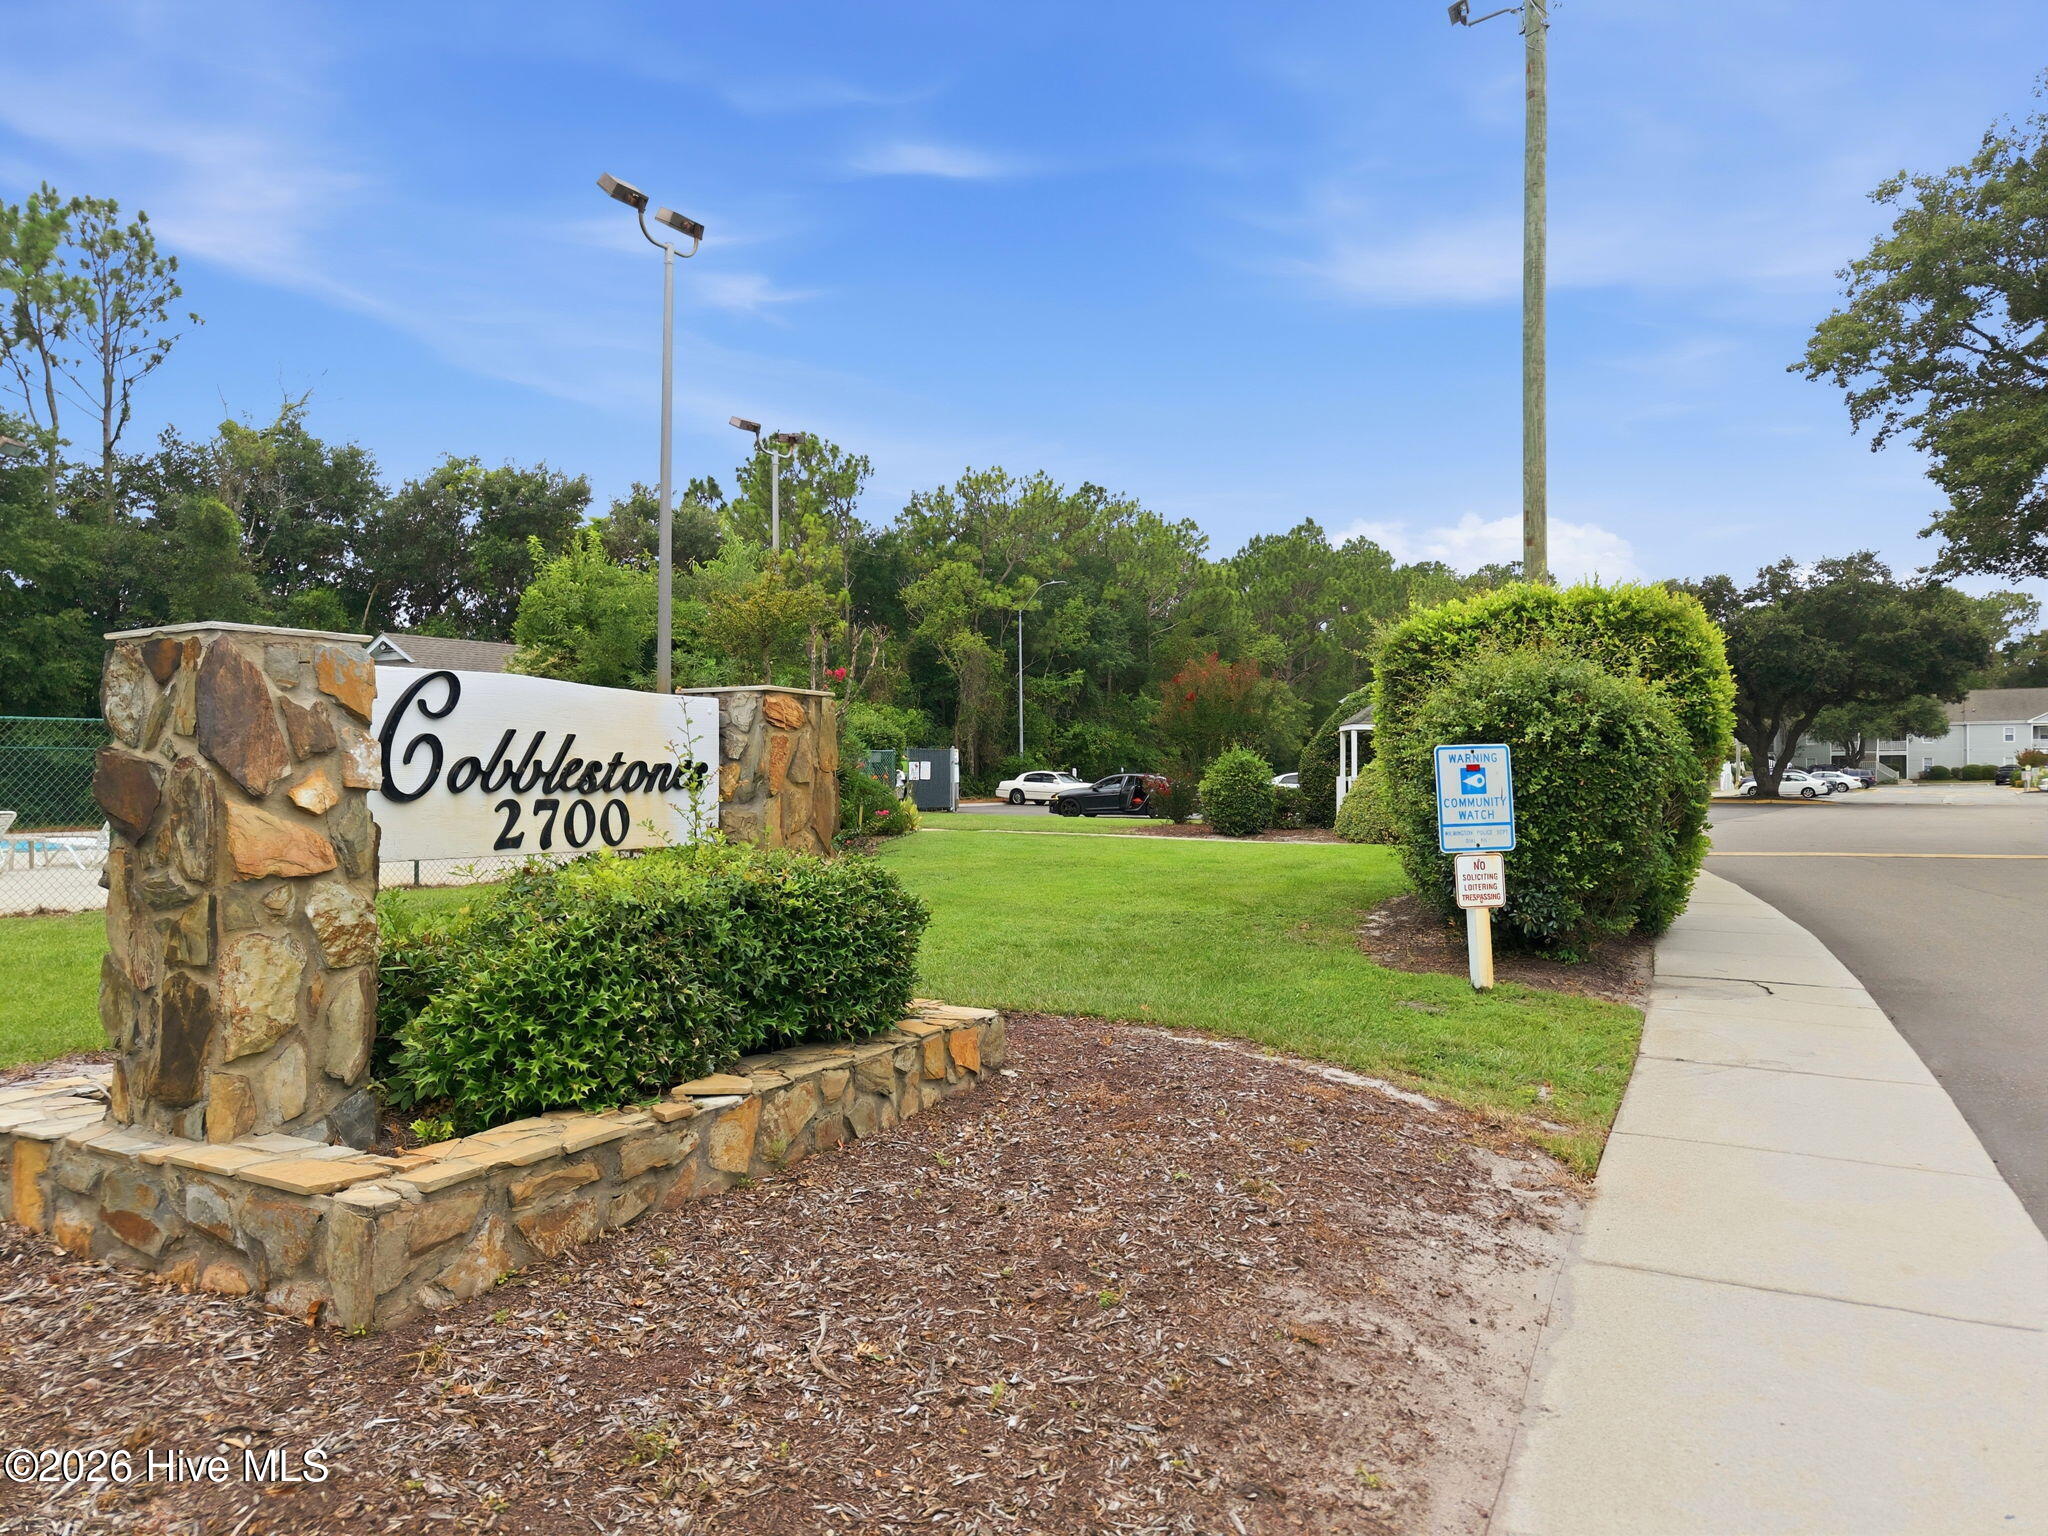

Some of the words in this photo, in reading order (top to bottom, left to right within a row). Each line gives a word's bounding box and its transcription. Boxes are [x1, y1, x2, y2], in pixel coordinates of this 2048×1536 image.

[1448, 752, 1498, 764] WARNING
[1443, 796, 1507, 808] COMMUNITY
[1458, 810, 1495, 820] WATCH
[493, 798, 630, 851] 2700
[1473, 860, 1486, 871] NO
[1462, 872, 1499, 881] SOLICITING
[1464, 882, 1498, 891] LOITERING
[1462, 892, 1501, 901] TRESPASSING
